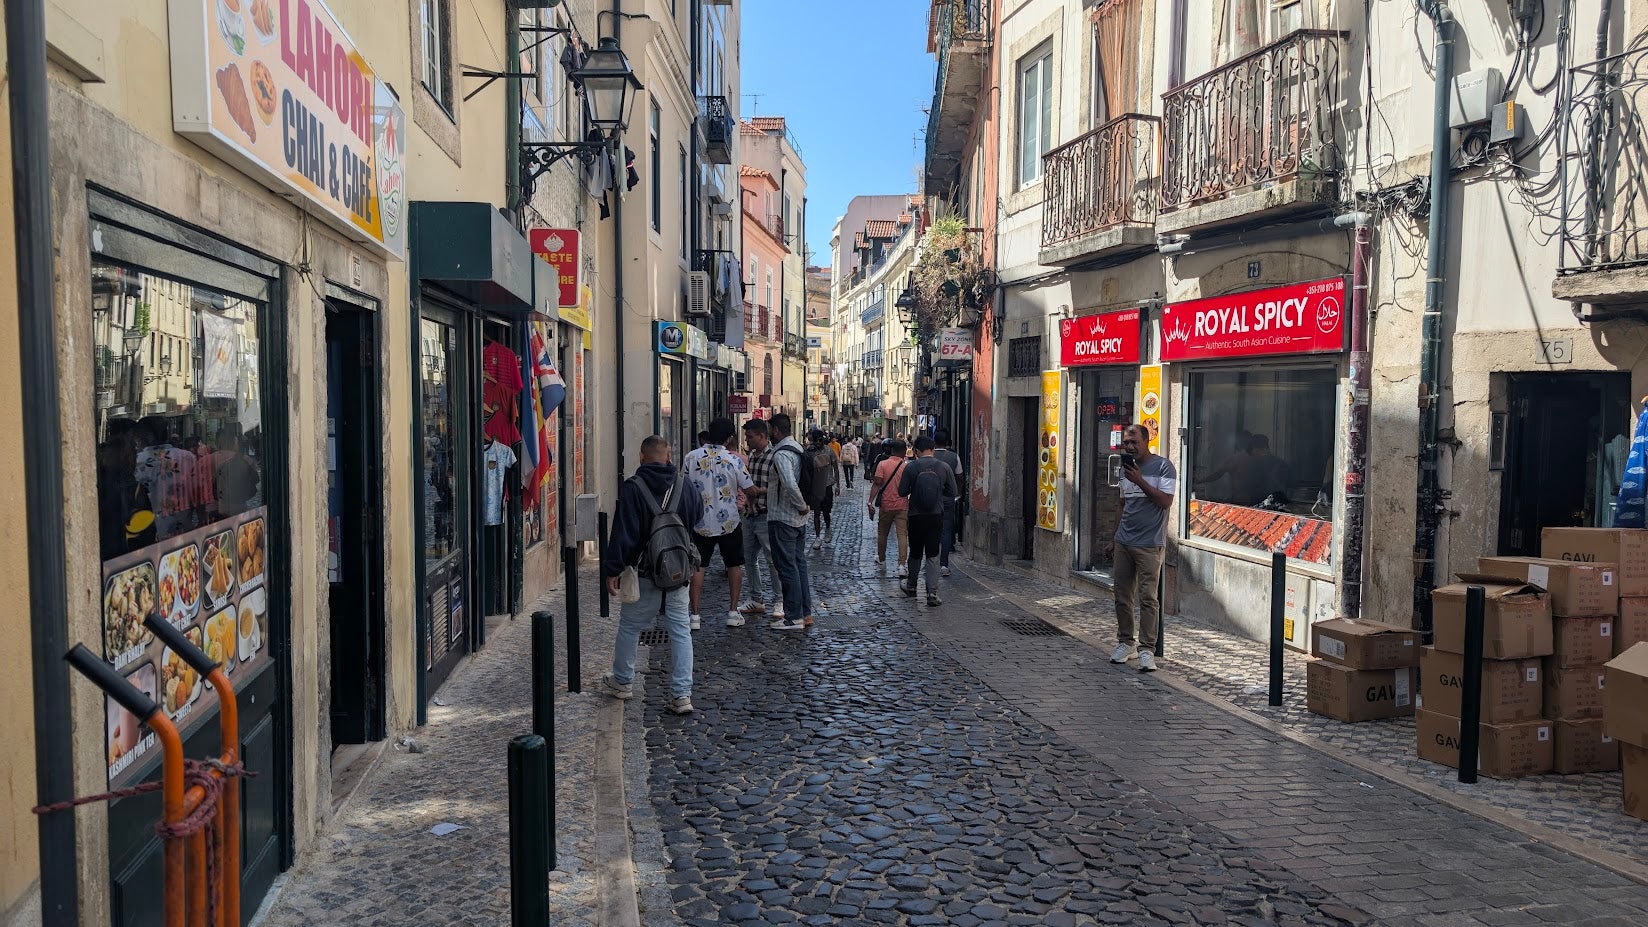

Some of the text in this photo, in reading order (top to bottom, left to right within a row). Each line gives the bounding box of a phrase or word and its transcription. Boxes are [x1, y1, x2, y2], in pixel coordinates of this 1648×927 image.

[279, 0, 371, 149] LAHORI
[282, 88, 372, 224] CHAI & CAFÉ
[1249, 262, 1259, 277] 73
[1195, 297, 1308, 337] ROYAL SPICY
[1318, 303, 1337, 320] حلال
[665, 328, 679, 342] M
[1205, 335, 1291, 350] Authentic South Asian Cuisine
[942, 344, 972, 355] 67-A
[1075, 337, 1122, 356] ROYAL SPICY
[1541, 340, 1564, 359] 75
[1097, 404, 1116, 416] OPEN
[1562, 552, 1595, 563] GAVI
[1440, 674, 1464, 689] GAV
[1366, 684, 1396, 702] GAV
[176, 703, 192, 723] SWEETS
[1435, 733, 1460, 750] GAV
[109, 731, 155, 781] KASHMIRI PINK TEA
